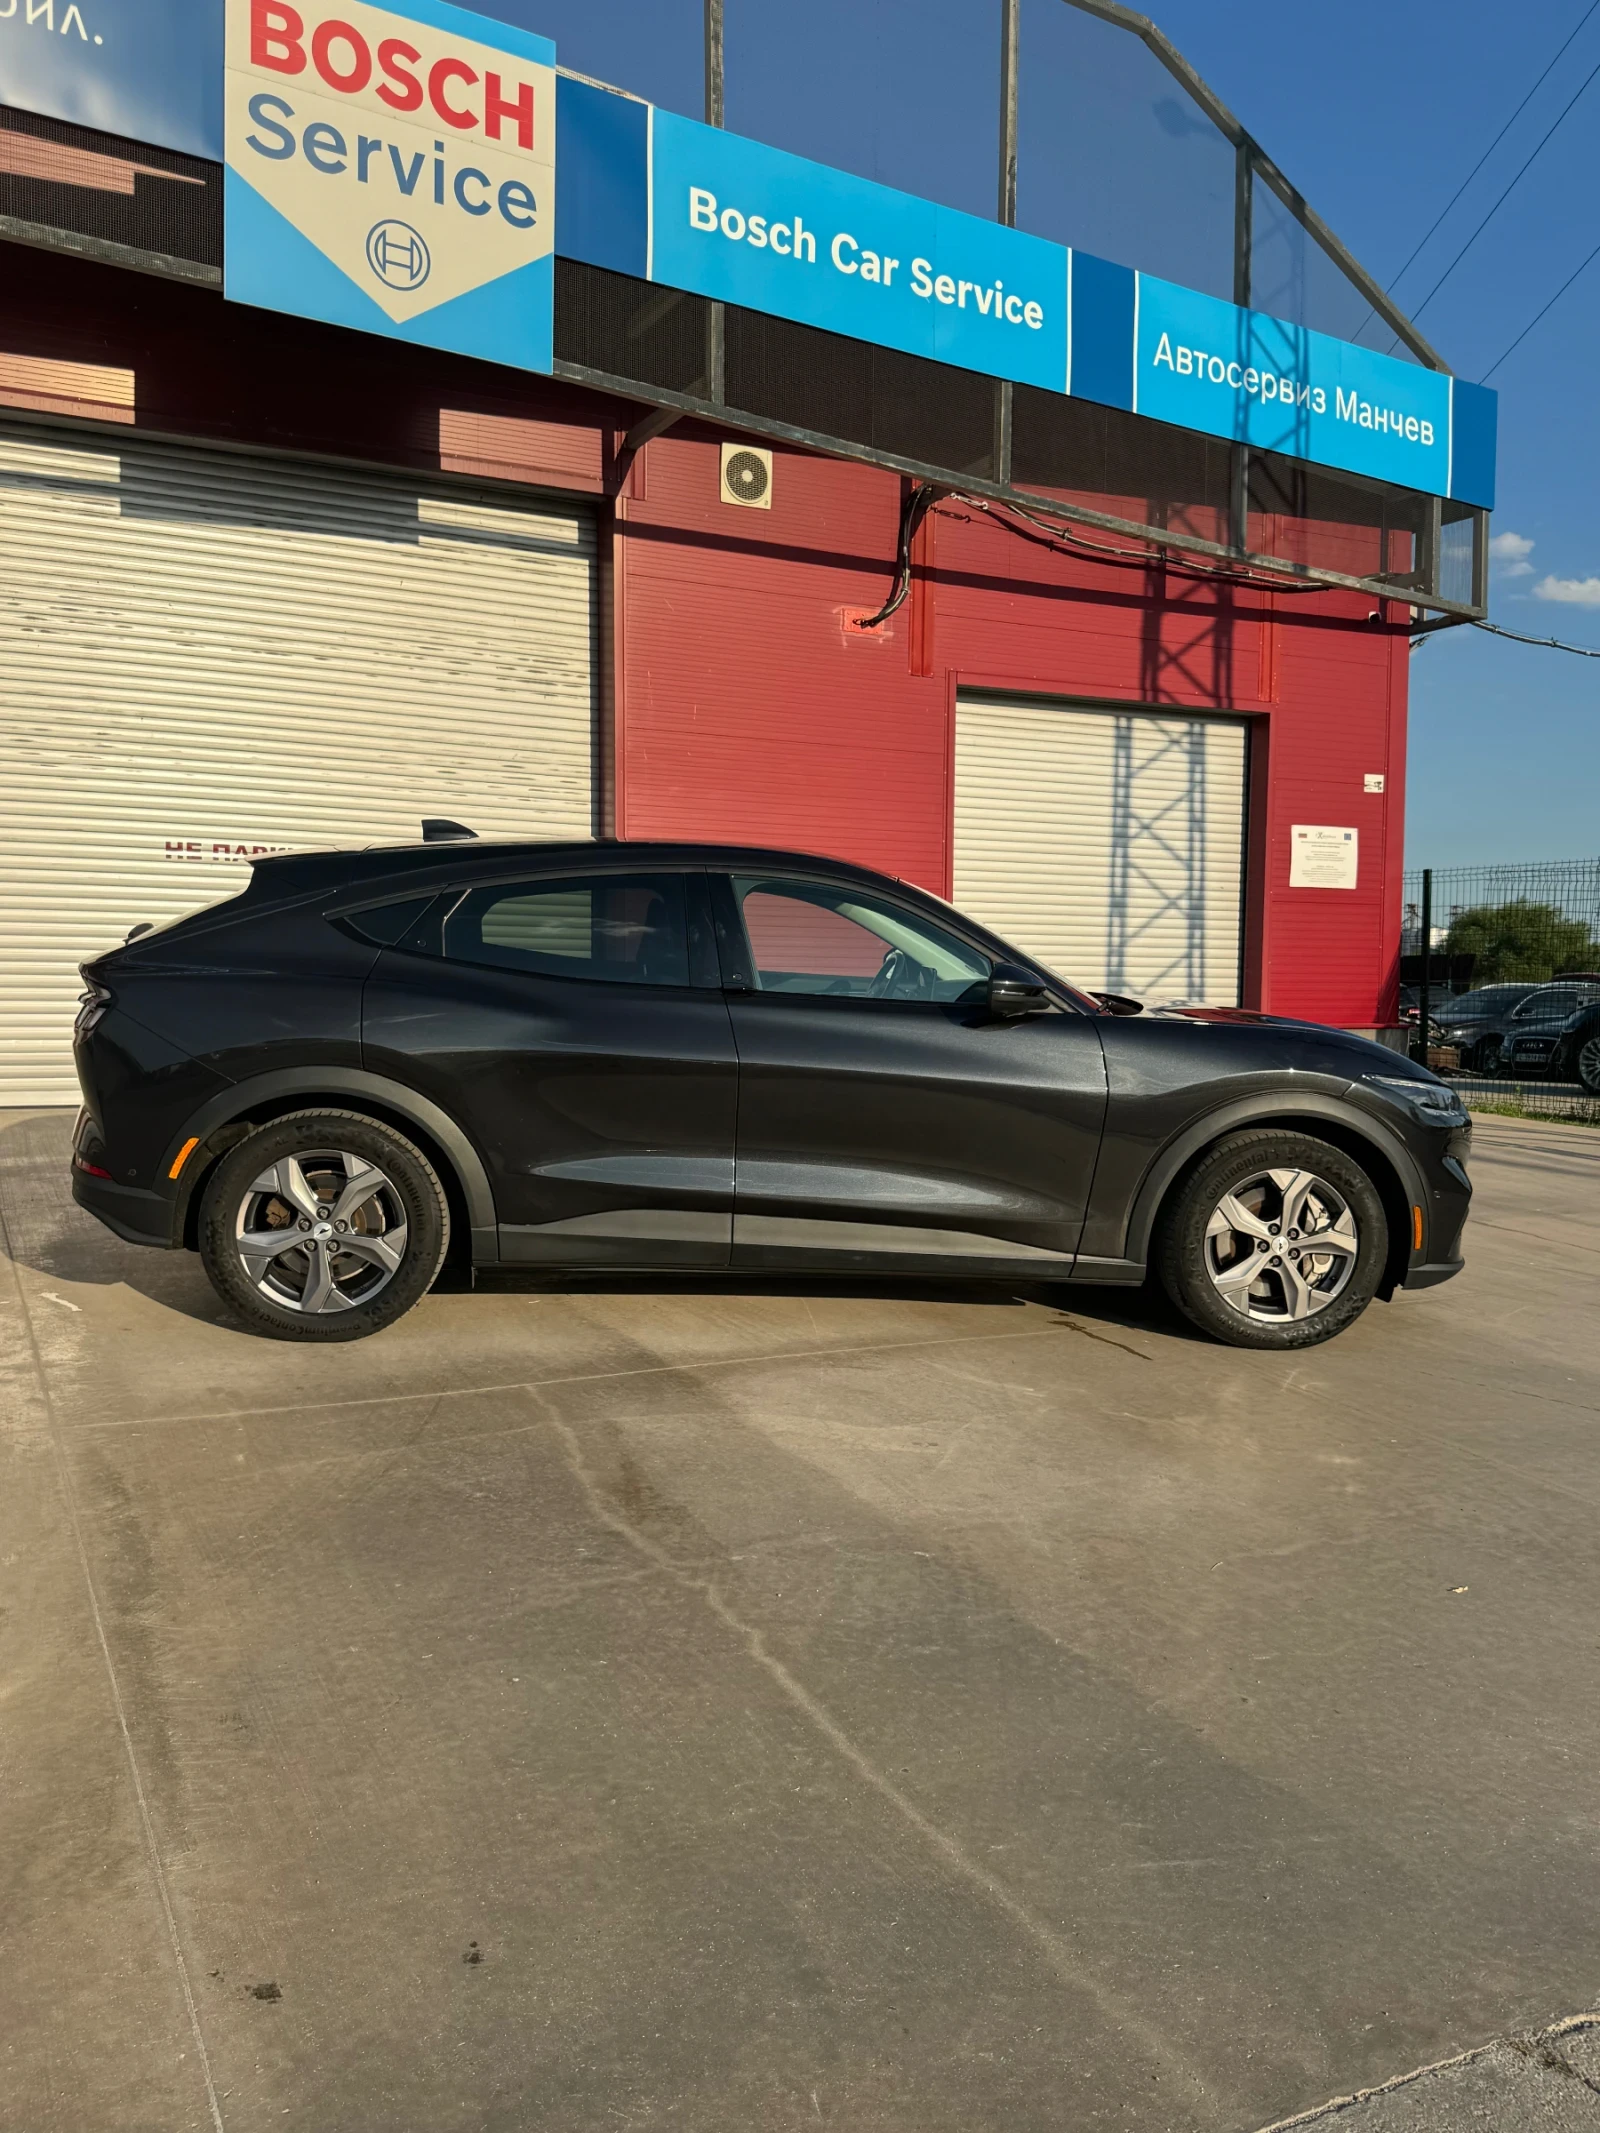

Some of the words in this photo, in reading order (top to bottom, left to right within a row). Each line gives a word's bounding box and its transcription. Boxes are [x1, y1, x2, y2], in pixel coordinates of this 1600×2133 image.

[250, 0, 534, 151] BOSCH
[246, 93, 537, 229] Service
[689, 186, 816, 264] Bosch
[831, 233, 899, 286] Car
[910, 257, 1044, 330] Service
[1153, 332, 1326, 414] Автосервиз
[1336, 387, 1434, 446] Манчев
[165, 841, 202, 860] НЕ
